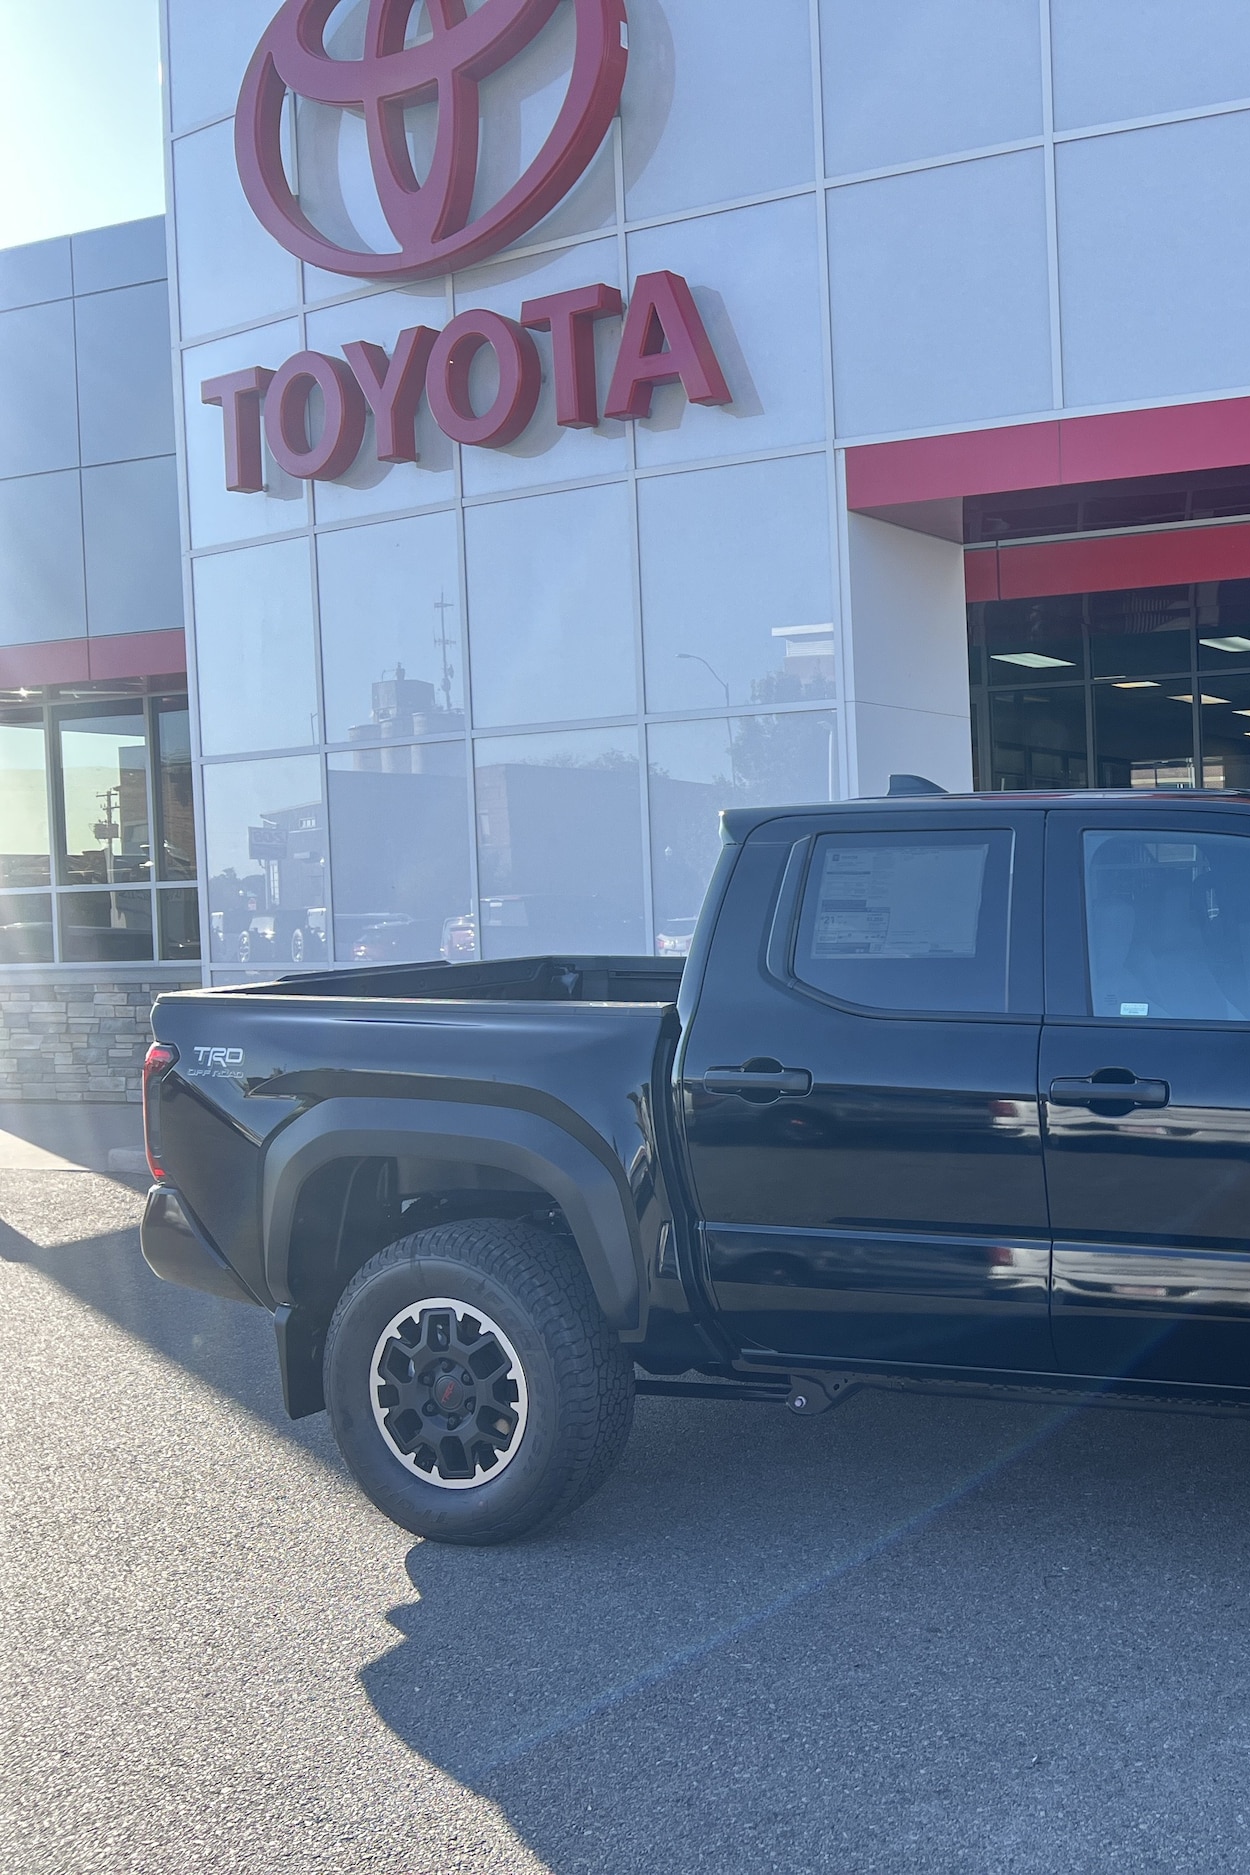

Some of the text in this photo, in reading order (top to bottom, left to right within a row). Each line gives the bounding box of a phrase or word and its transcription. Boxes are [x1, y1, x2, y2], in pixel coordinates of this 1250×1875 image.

[201, 269, 733, 494] TOYOTA
[193, 1046, 245, 1068] TRD
[187, 1068, 245, 1079] OFF ROAD
